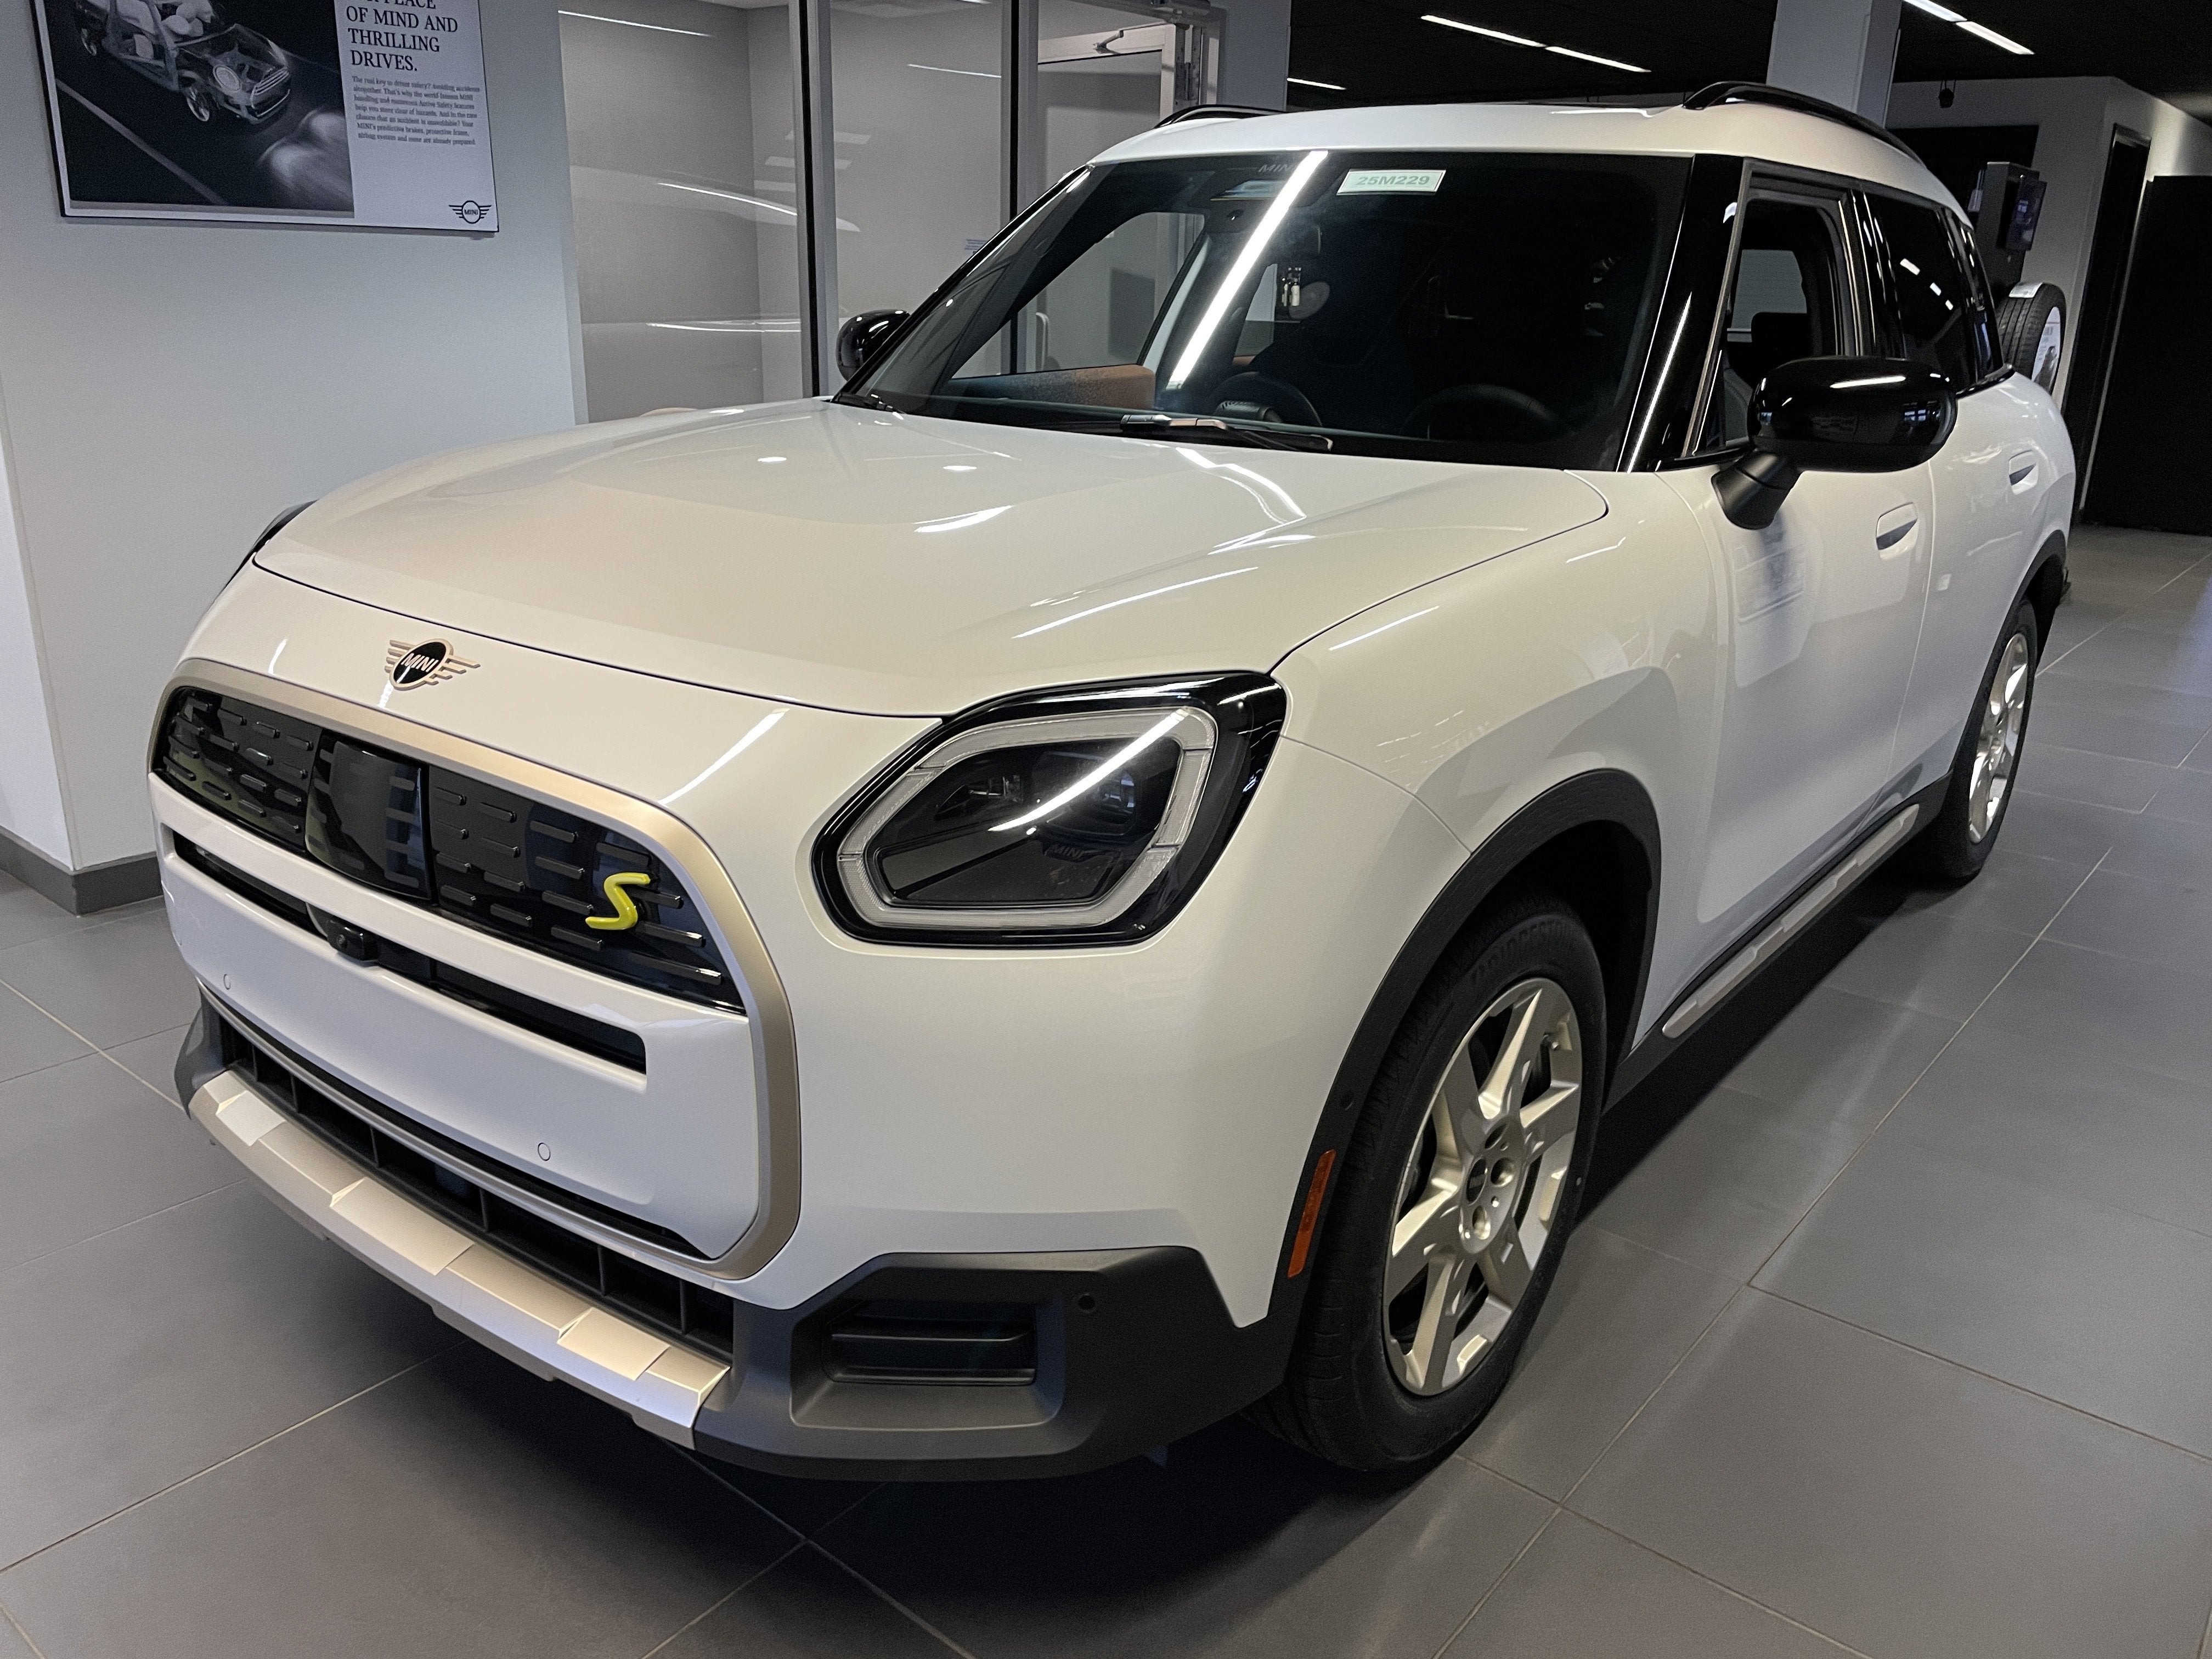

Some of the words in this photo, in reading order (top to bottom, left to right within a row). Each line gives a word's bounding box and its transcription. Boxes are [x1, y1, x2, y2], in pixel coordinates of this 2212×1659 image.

[346, 5, 368, 22] OF
[374, 8, 419, 29] MIND
[424, 15, 458, 32] AND
[348, 28, 439, 52] THRILLING
[350, 50, 417, 72] DRIVES.
[1355, 175, 1431, 186] 25M229
[400, 652, 439, 673] MINI
[585, 872, 651, 930] S
